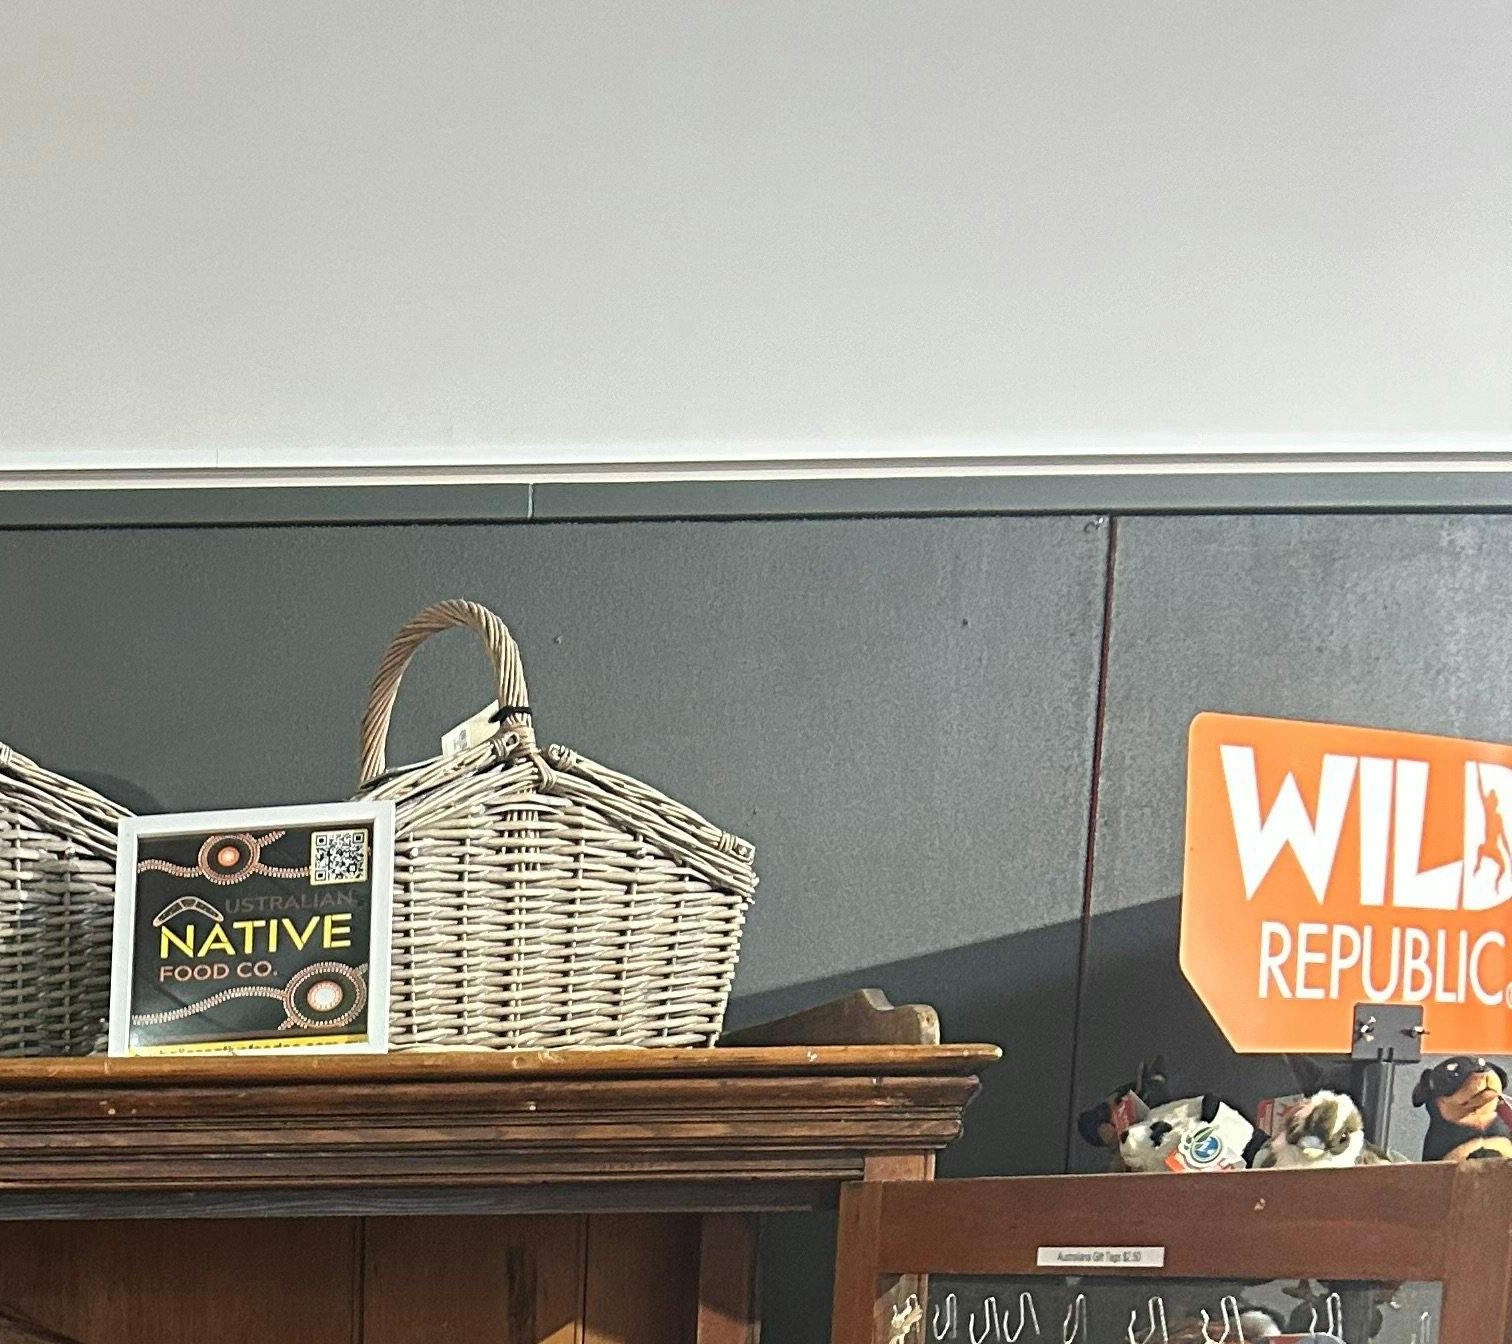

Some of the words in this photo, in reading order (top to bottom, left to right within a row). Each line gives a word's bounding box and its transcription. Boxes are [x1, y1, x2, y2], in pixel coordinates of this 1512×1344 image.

[1219, 744, 1512, 911] WILD
[159, 912, 353, 959] NATIVE
[1258, 921, 1508, 1005] REPUBLIC
[159, 962, 230, 983] FOOD
[236, 960, 278, 978] CO.
